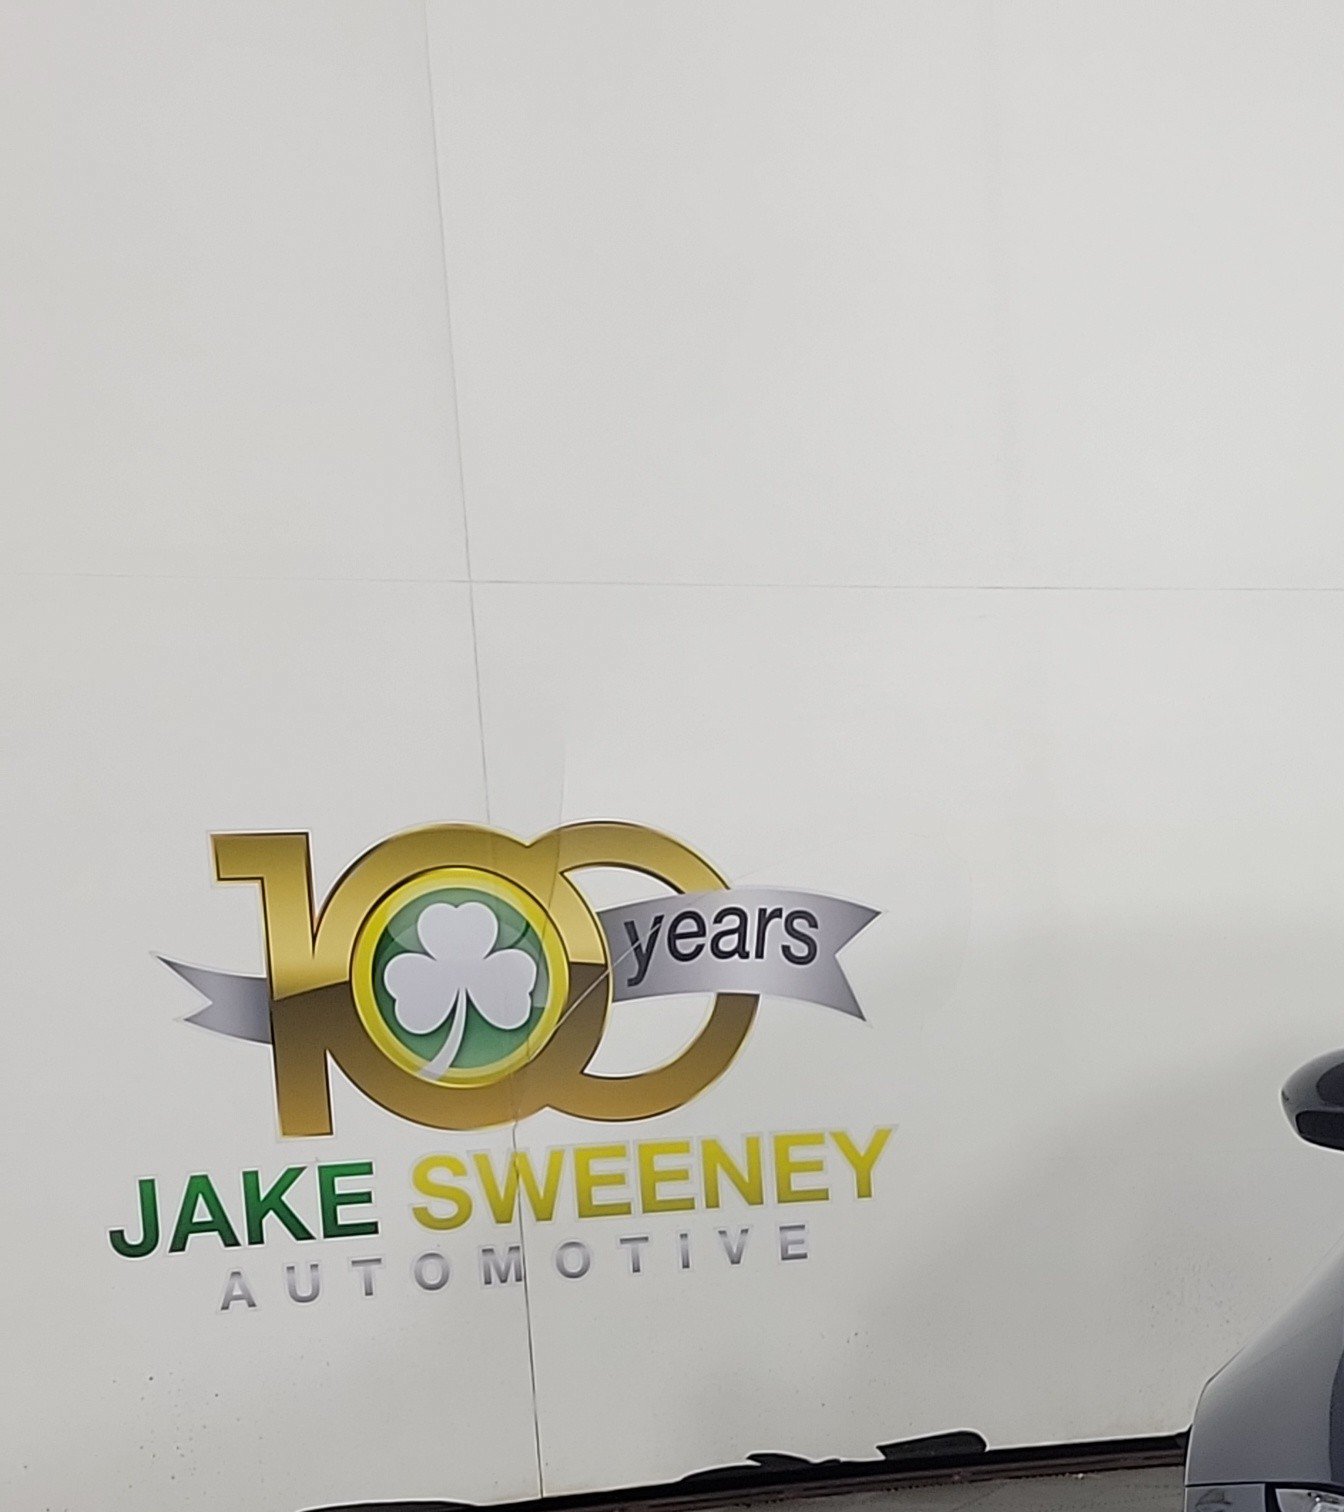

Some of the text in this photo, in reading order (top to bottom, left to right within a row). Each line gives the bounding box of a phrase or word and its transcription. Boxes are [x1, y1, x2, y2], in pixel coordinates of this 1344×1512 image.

[212, 821, 820, 1138] 100 years
[108, 1128, 894, 1259] JAKE SWEENEY
[219, 1225, 810, 1312] AUTOMOTIVE
